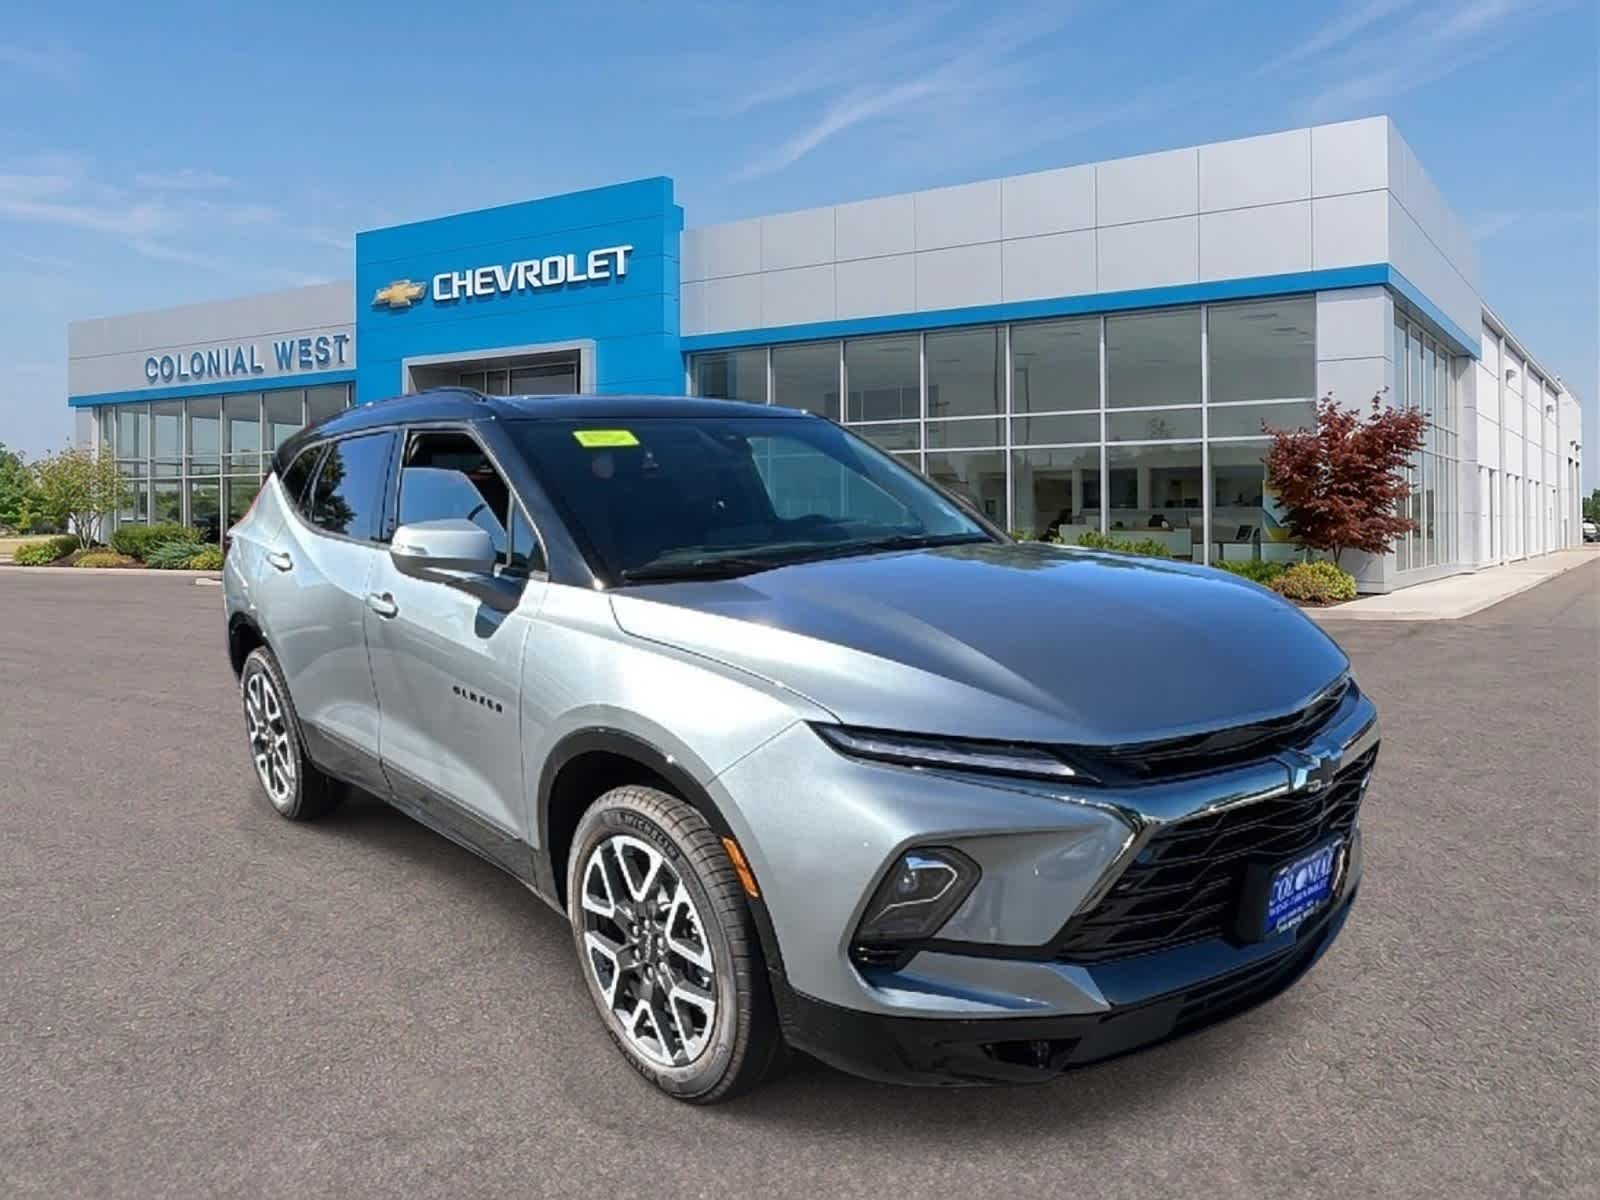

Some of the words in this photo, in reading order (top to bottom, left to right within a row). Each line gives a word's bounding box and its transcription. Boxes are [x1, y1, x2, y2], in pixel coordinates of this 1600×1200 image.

[433, 245, 633, 301] CHEVROLET
[145, 345, 264, 382] COLONIAL
[274, 334, 349, 369] WEST
